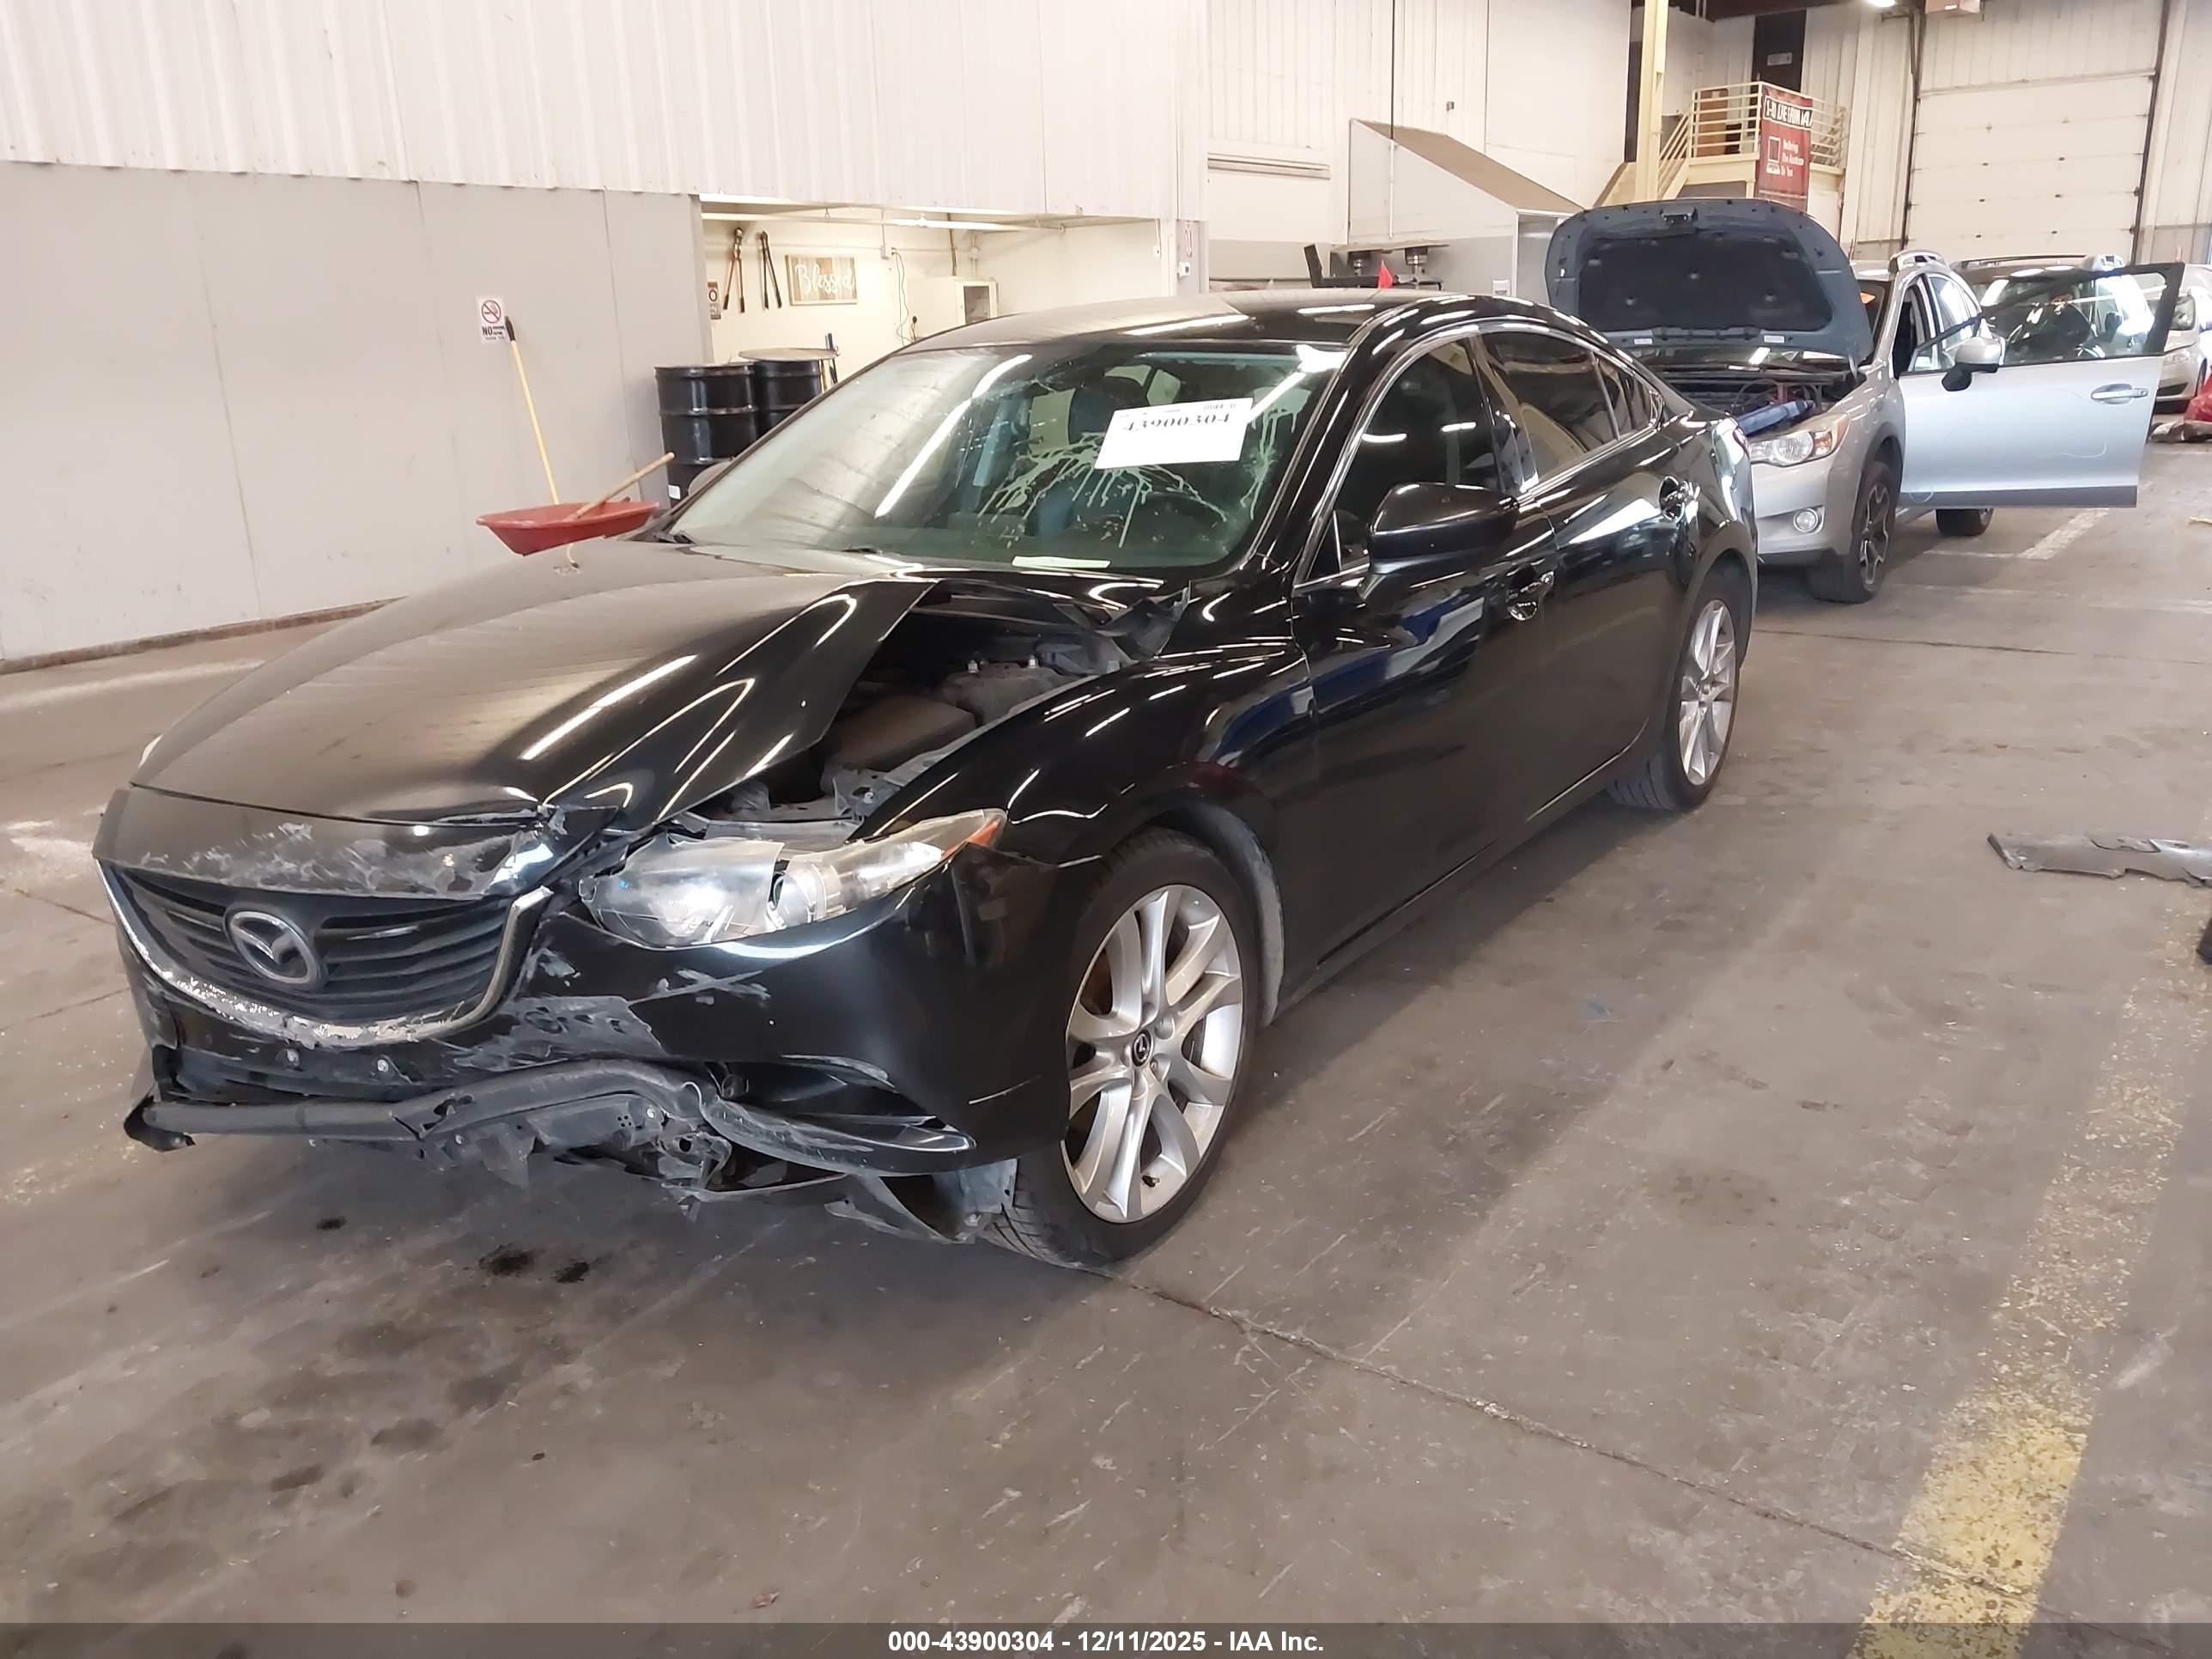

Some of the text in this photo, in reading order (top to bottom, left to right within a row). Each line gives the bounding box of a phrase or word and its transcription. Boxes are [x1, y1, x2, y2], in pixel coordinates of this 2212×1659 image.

[795, 264, 854, 295] Blessed
[482, 326, 493, 335] NO
[1122, 413, 1230, 431] 43900304
